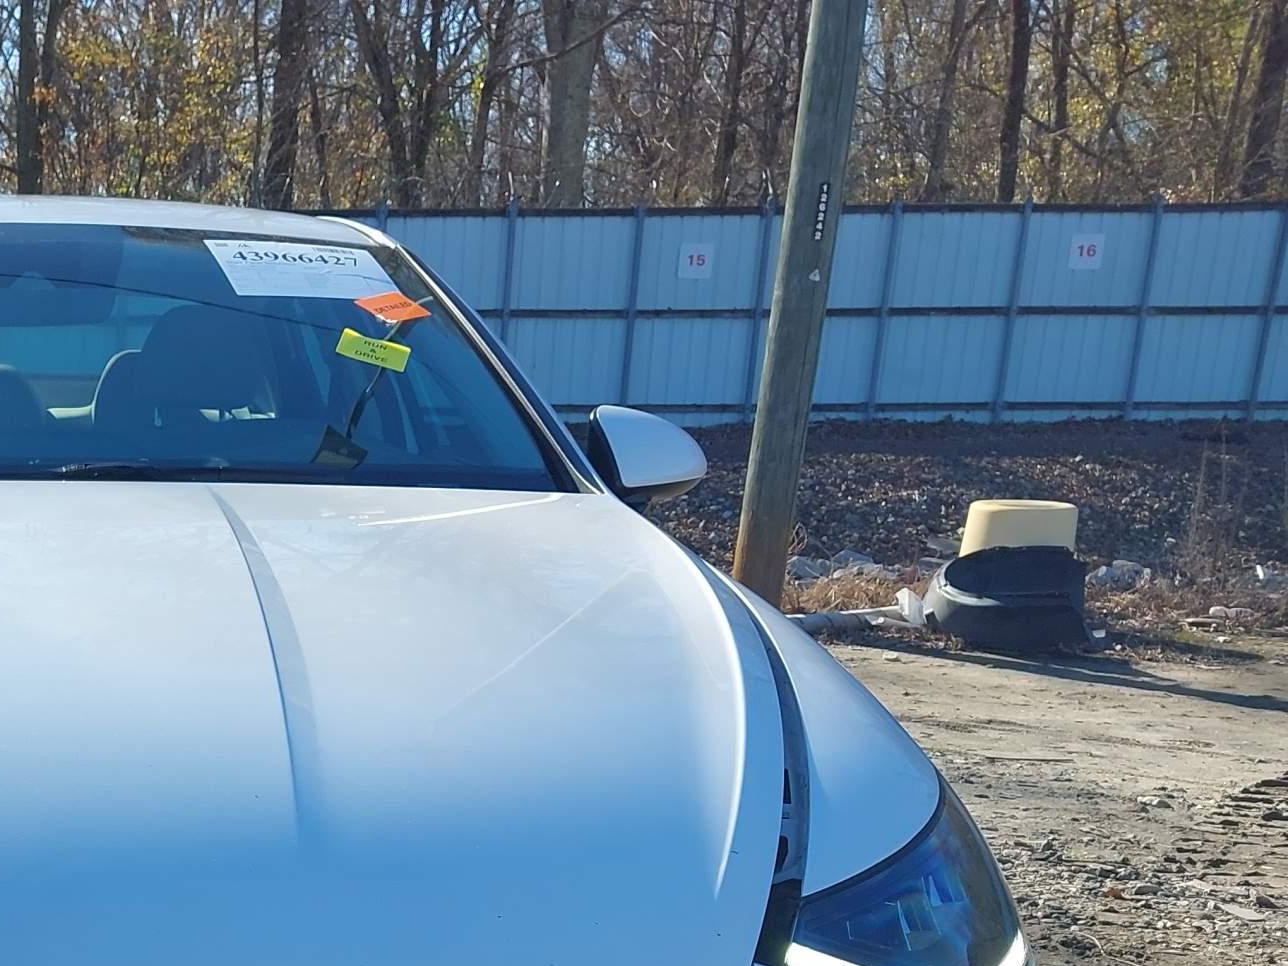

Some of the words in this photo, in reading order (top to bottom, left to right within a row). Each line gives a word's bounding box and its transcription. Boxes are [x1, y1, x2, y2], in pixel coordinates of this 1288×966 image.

[814, 183, 828, 241] 126242
[1076, 244, 1097, 257] 16
[232, 250, 358, 267] 43966427
[687, 254, 706, 267] 15
[363, 340, 388, 350] RUN
[354, 350, 388, 362] DRIVE
